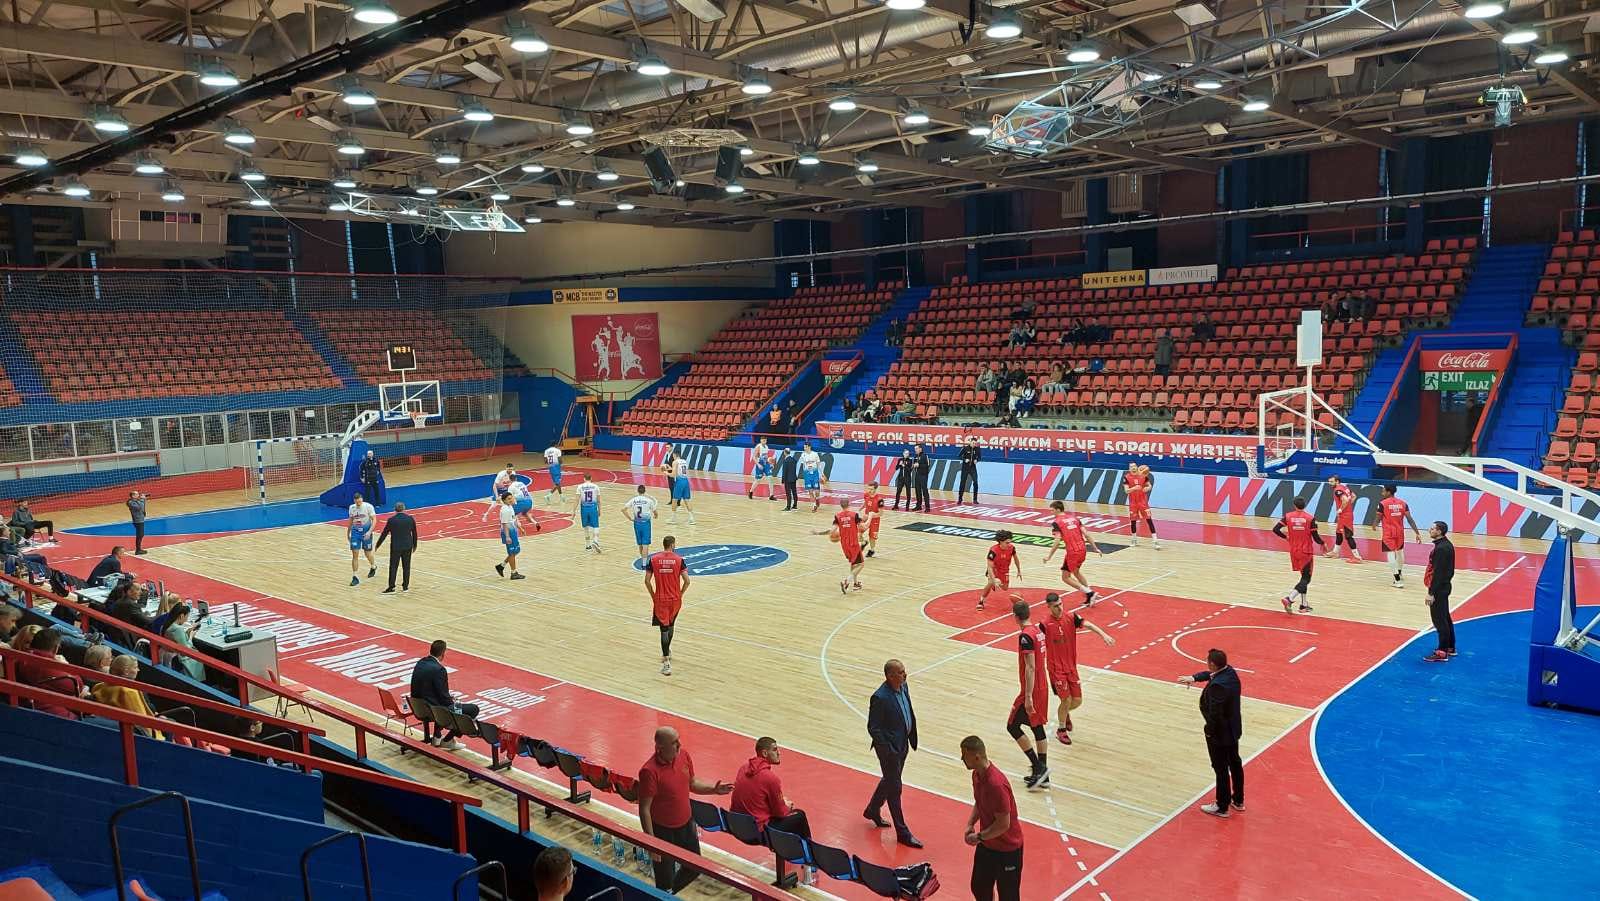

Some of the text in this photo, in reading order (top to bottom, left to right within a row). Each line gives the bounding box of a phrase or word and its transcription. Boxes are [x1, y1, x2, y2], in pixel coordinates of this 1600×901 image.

[1084, 274, 1145, 285] UNITEHNA
[1441, 372, 1465, 383] EXIT
[1465, 380, 1490, 390] IZLAZ
[636, 506, 643, 519] 2
